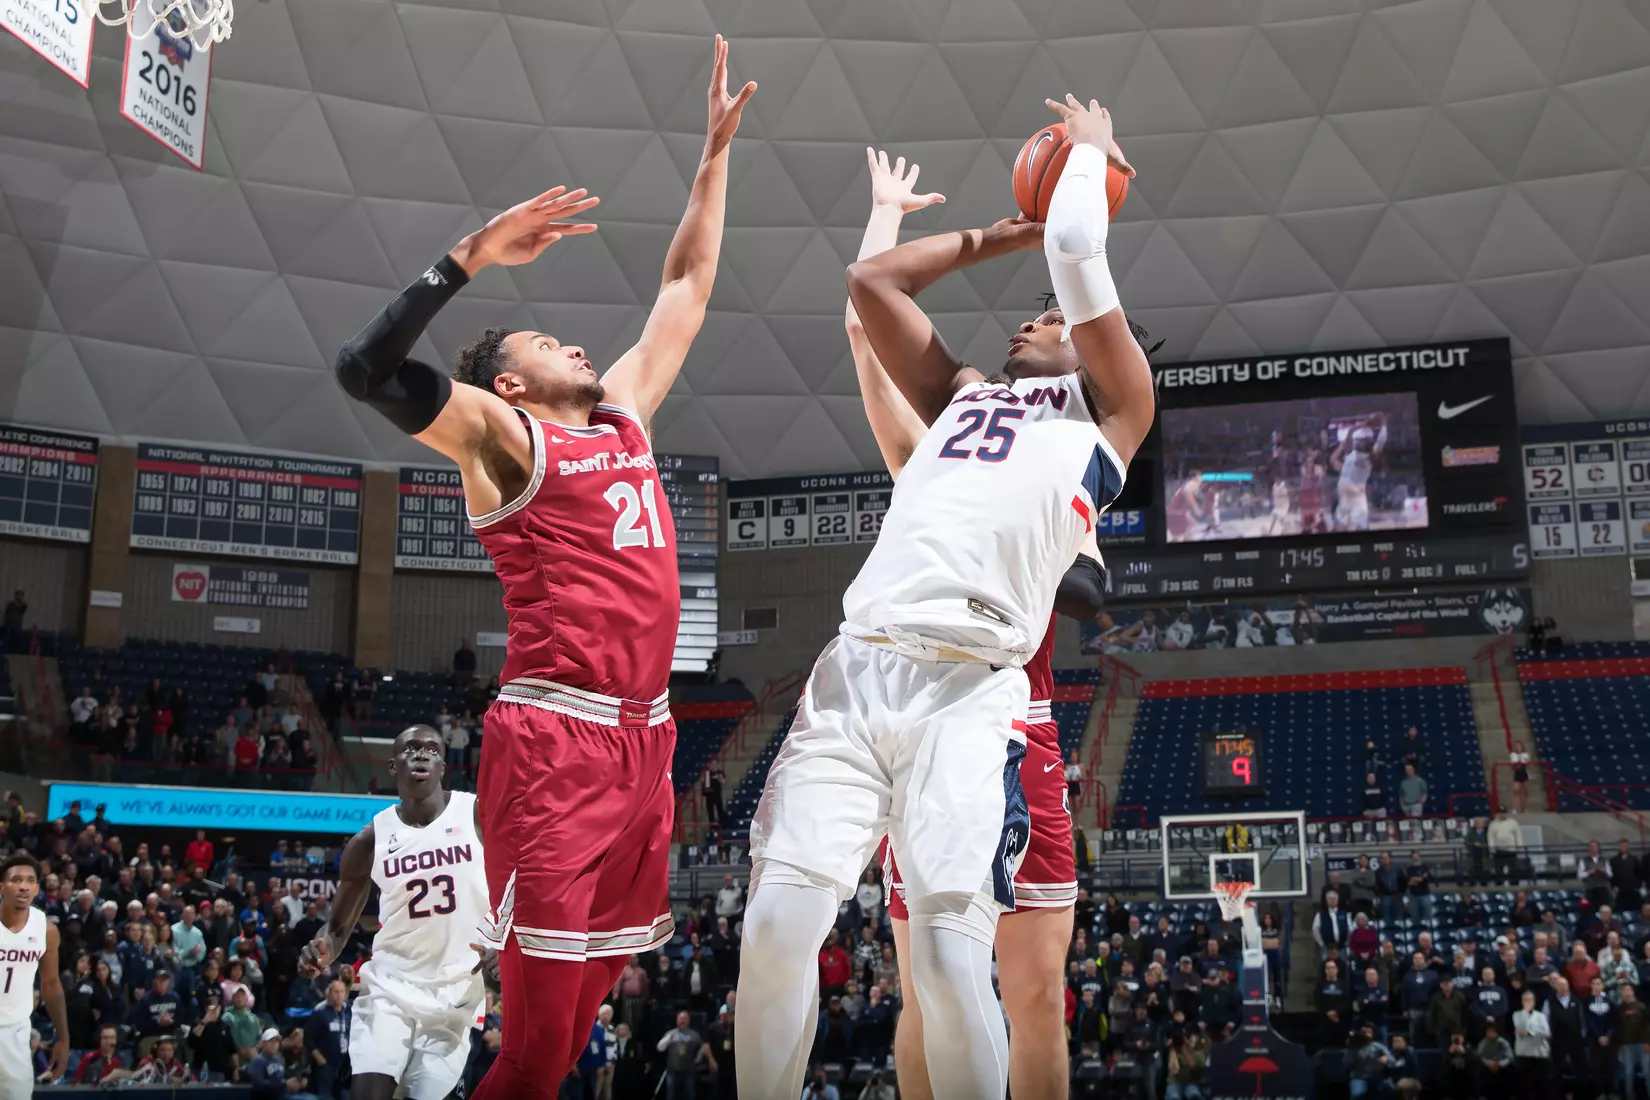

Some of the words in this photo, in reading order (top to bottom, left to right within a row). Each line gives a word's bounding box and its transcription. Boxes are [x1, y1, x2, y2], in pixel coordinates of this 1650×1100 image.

[6, 9, 77, 71] CHAMPIONS
[138, 50, 197, 117] 2016
[139, 87, 192, 136] NATIONAL
[132, 104, 195, 157] CHAMPIONS
[1255, 350, 1288, 380] OF
[1293, 347, 1470, 377] CONNECTICUT
[937, 407, 1027, 463] 25
[1604, 421, 1650, 434] UCON
[148, 448, 205, 463] NATIONAL
[209, 455, 273, 469] INVITATION
[277, 460, 353, 477] TOURNAMENT
[557, 452, 609, 476] SAINT
[200, 464, 303, 485] APPEARANCES
[412, 471, 461, 484] NCAA
[800, 477, 847, 489] UCONN
[1531, 468, 1564, 489] 52
[173, 476, 198, 494] 1974
[207, 479, 230, 497] 1975
[205, 501, 229, 518] 1997
[300, 509, 325, 526] 2015
[603, 479, 666, 551] 21
[1442, 502, 1498, 514] TRAVELERS
[783, 517, 795, 537] 9
[817, 515, 846, 535] 22
[1098, 511, 1141, 527] CBS
[737, 520, 756, 540] C
[1544, 526, 1562, 547] 15
[1591, 523, 1612, 544] 22
[137, 536, 226, 553] CONNECTICUT
[273, 549, 353, 563] BASKETBALL
[1280, 549, 1325, 568] 17:45
[402, 558, 485, 570] CONNECTICUT
[1414, 566, 1433, 577] SEC
[1454, 563, 1477, 574] FULL
[179, 578, 202, 590] NIT
[242, 569, 279, 583] 1988
[1182, 579, 1200, 590] SEC
[1237, 576, 1254, 587] FLS
[1361, 569, 1378, 580] FLS
[209, 580, 252, 593] NATIONAL
[257, 583, 309, 597] INVITATION
[1127, 583, 1148, 594] FULL
[1315, 602, 1340, 614] Harry
[1352, 599, 1389, 611] Gampel
[1390, 598, 1426, 608] Pavilion
[1465, 594, 1479, 604] CT
[1327, 611, 1374, 624] Basketball
[1376, 609, 1409, 622] Capital
[1410, 608, 1422, 618] of
[1422, 607, 1438, 618] the
[1439, 605, 1469, 616] World
[1232, 756, 1251, 785] 9
[120, 801, 166, 815] WE'VE
[169, 803, 225, 818] ALWAYS
[226, 805, 256, 818] GOT
[292, 808, 333, 822] GAME
[335, 811, 367, 823] FACE
[383, 843, 473, 878] UCONN
[1328, 861, 1346, 870] SEC
[405, 874, 457, 920] 23
[0, 948, 42, 962] CONN
[3, 966, 14, 994] 1
